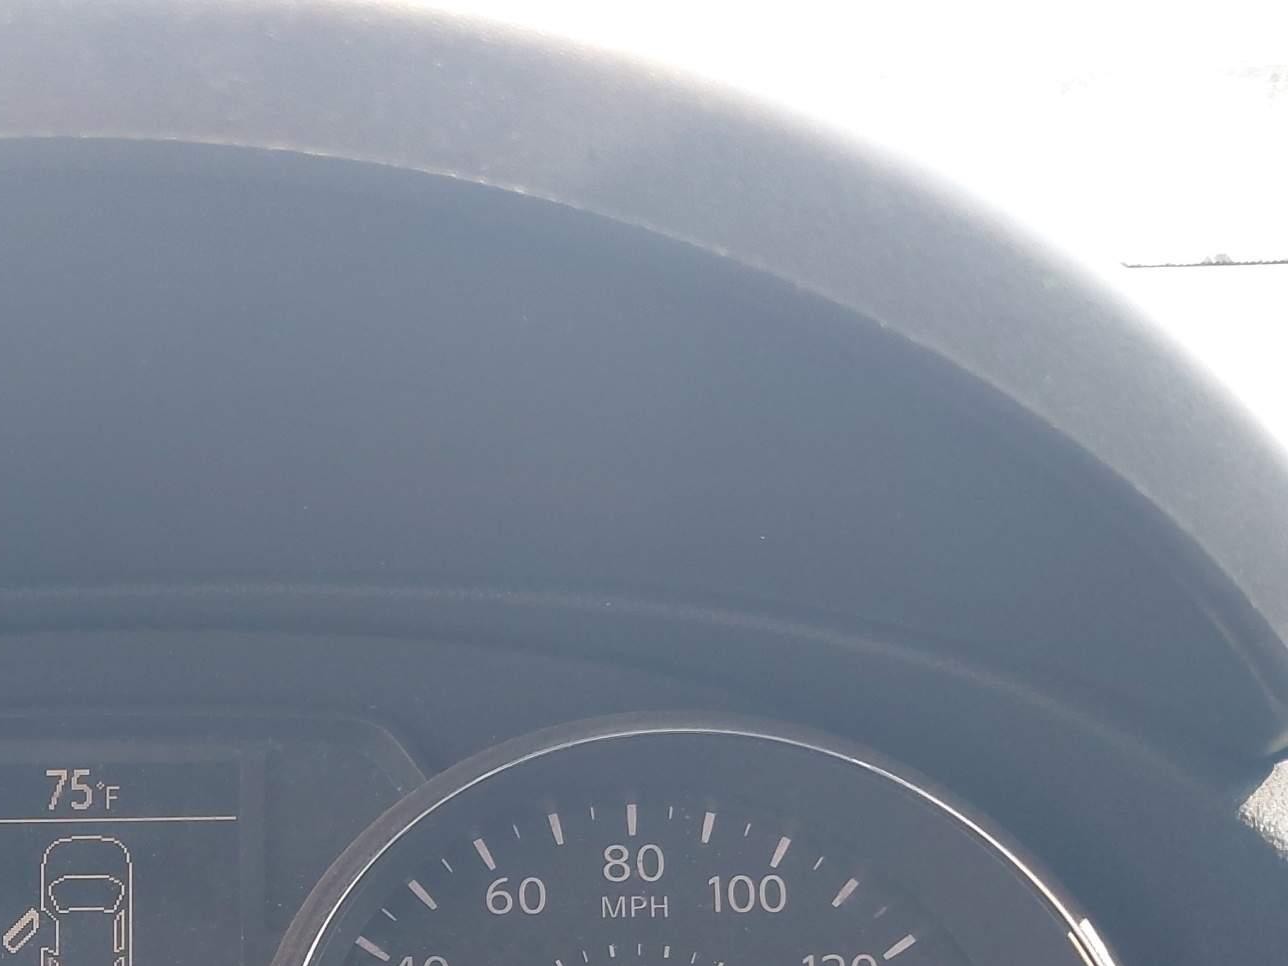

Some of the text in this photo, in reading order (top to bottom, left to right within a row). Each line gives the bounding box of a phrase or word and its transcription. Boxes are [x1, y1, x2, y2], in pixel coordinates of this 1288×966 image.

[602, 844, 665, 882] 80
[485, 877, 546, 915] 60
[601, 896, 669, 918] MPH
[708, 874, 787, 913] 100
